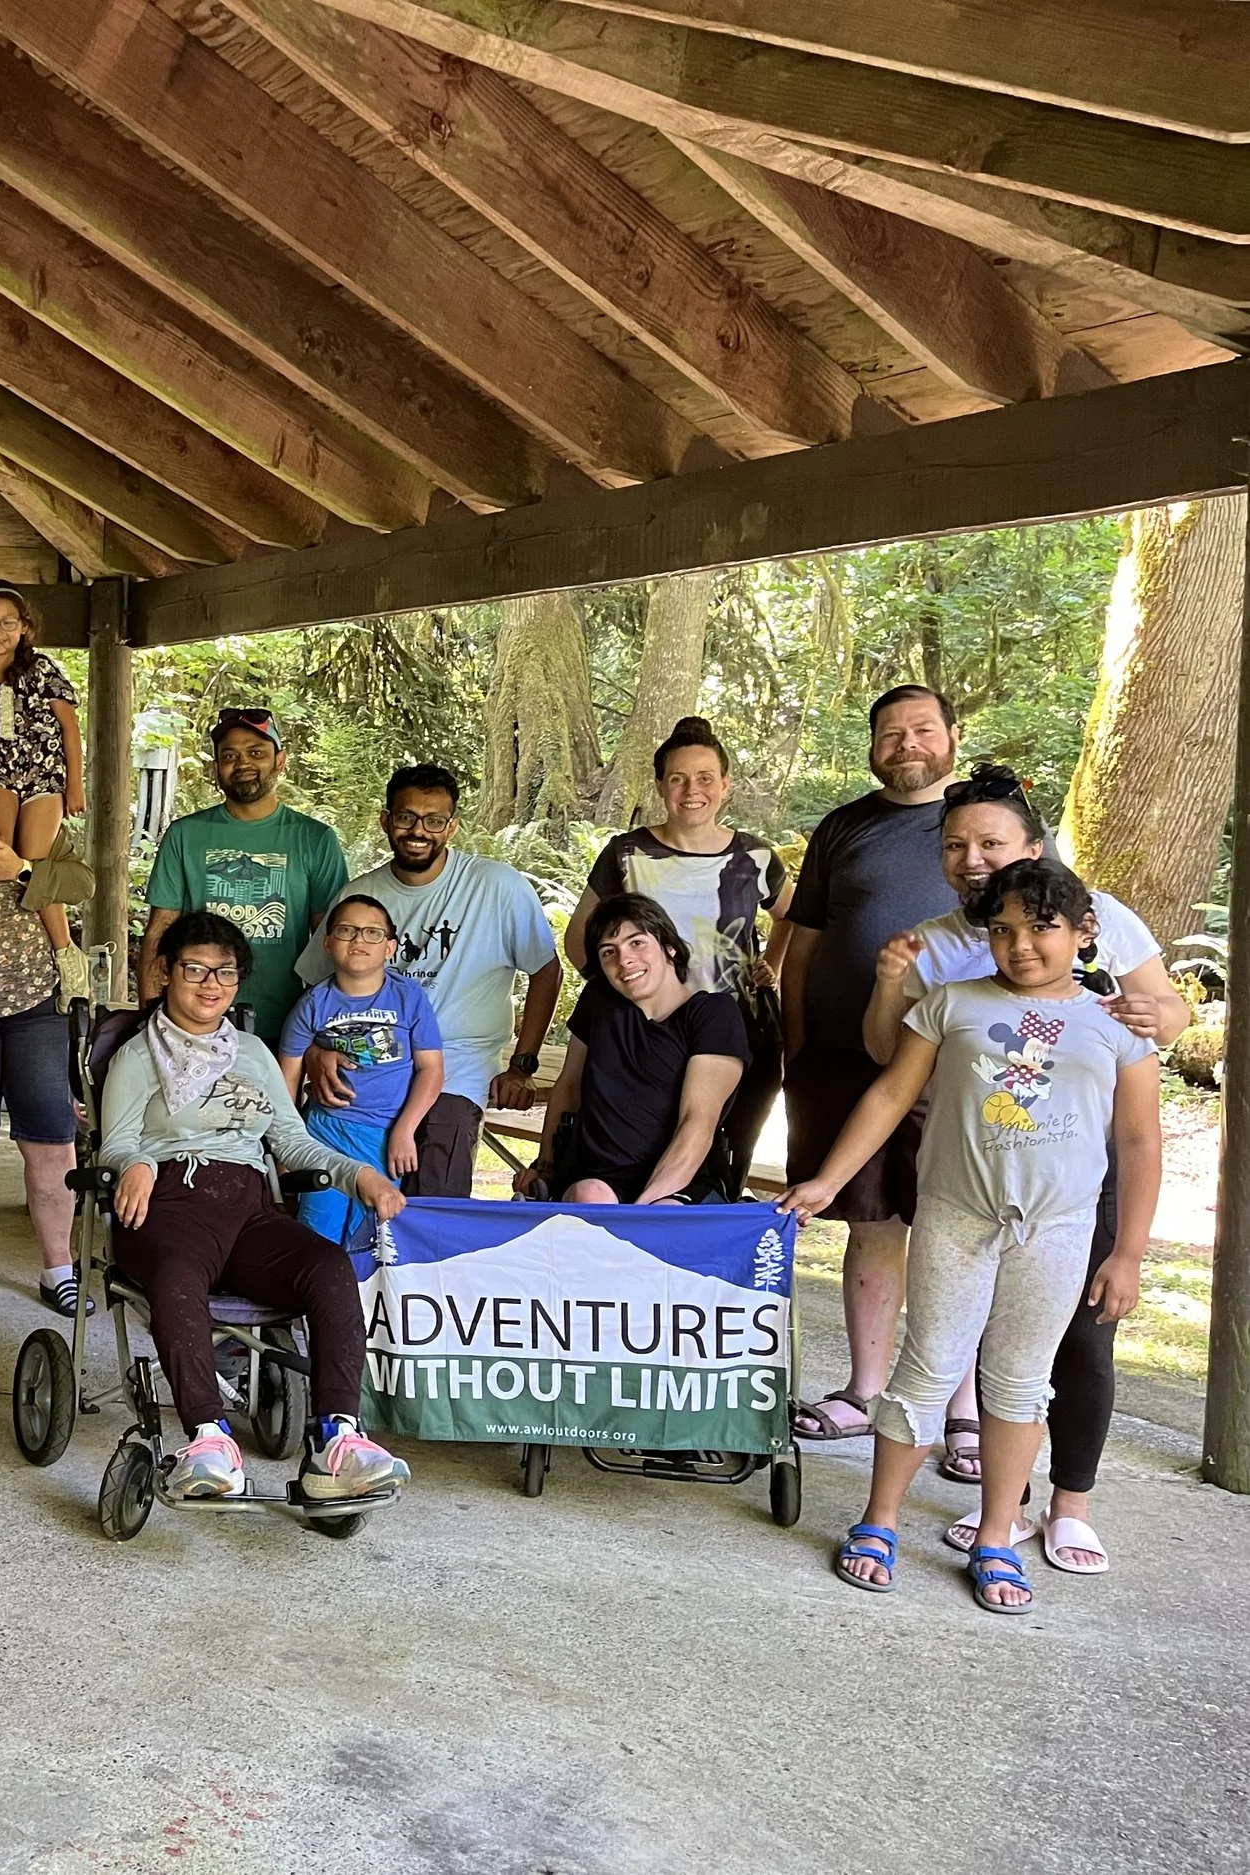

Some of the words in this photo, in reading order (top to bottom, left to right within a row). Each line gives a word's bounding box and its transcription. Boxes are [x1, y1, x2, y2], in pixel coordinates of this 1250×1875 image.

[206, 902, 258, 921] HOOD
[239, 923, 285, 938] OAST
[198, 1075, 274, 1115] Paris
[982, 1114, 1060, 1140] Minnie
[366, 1290, 779, 1360] ADVENTURES
[366, 1351, 597, 1405] WITHOUT
[610, 1366, 777, 1412] LIMITS
[485, 1423, 637, 1444] www.awloutdoors.org
